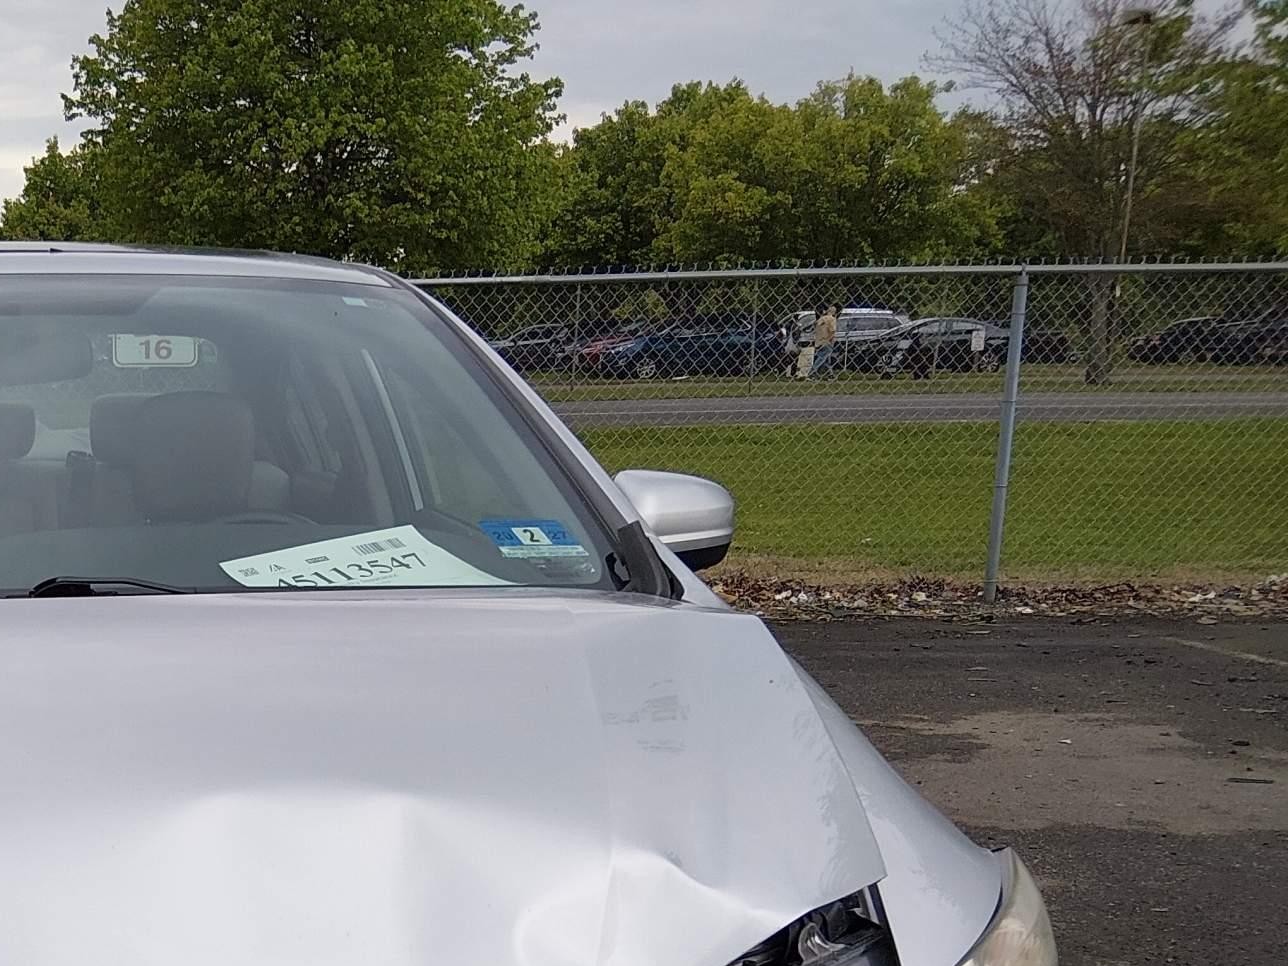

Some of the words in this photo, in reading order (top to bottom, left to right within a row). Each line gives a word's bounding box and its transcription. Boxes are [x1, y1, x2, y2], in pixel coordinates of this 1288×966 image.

[139, 339, 172, 360] 16
[522, 529, 540, 542] 2
[278, 552, 426, 588] 45113547
